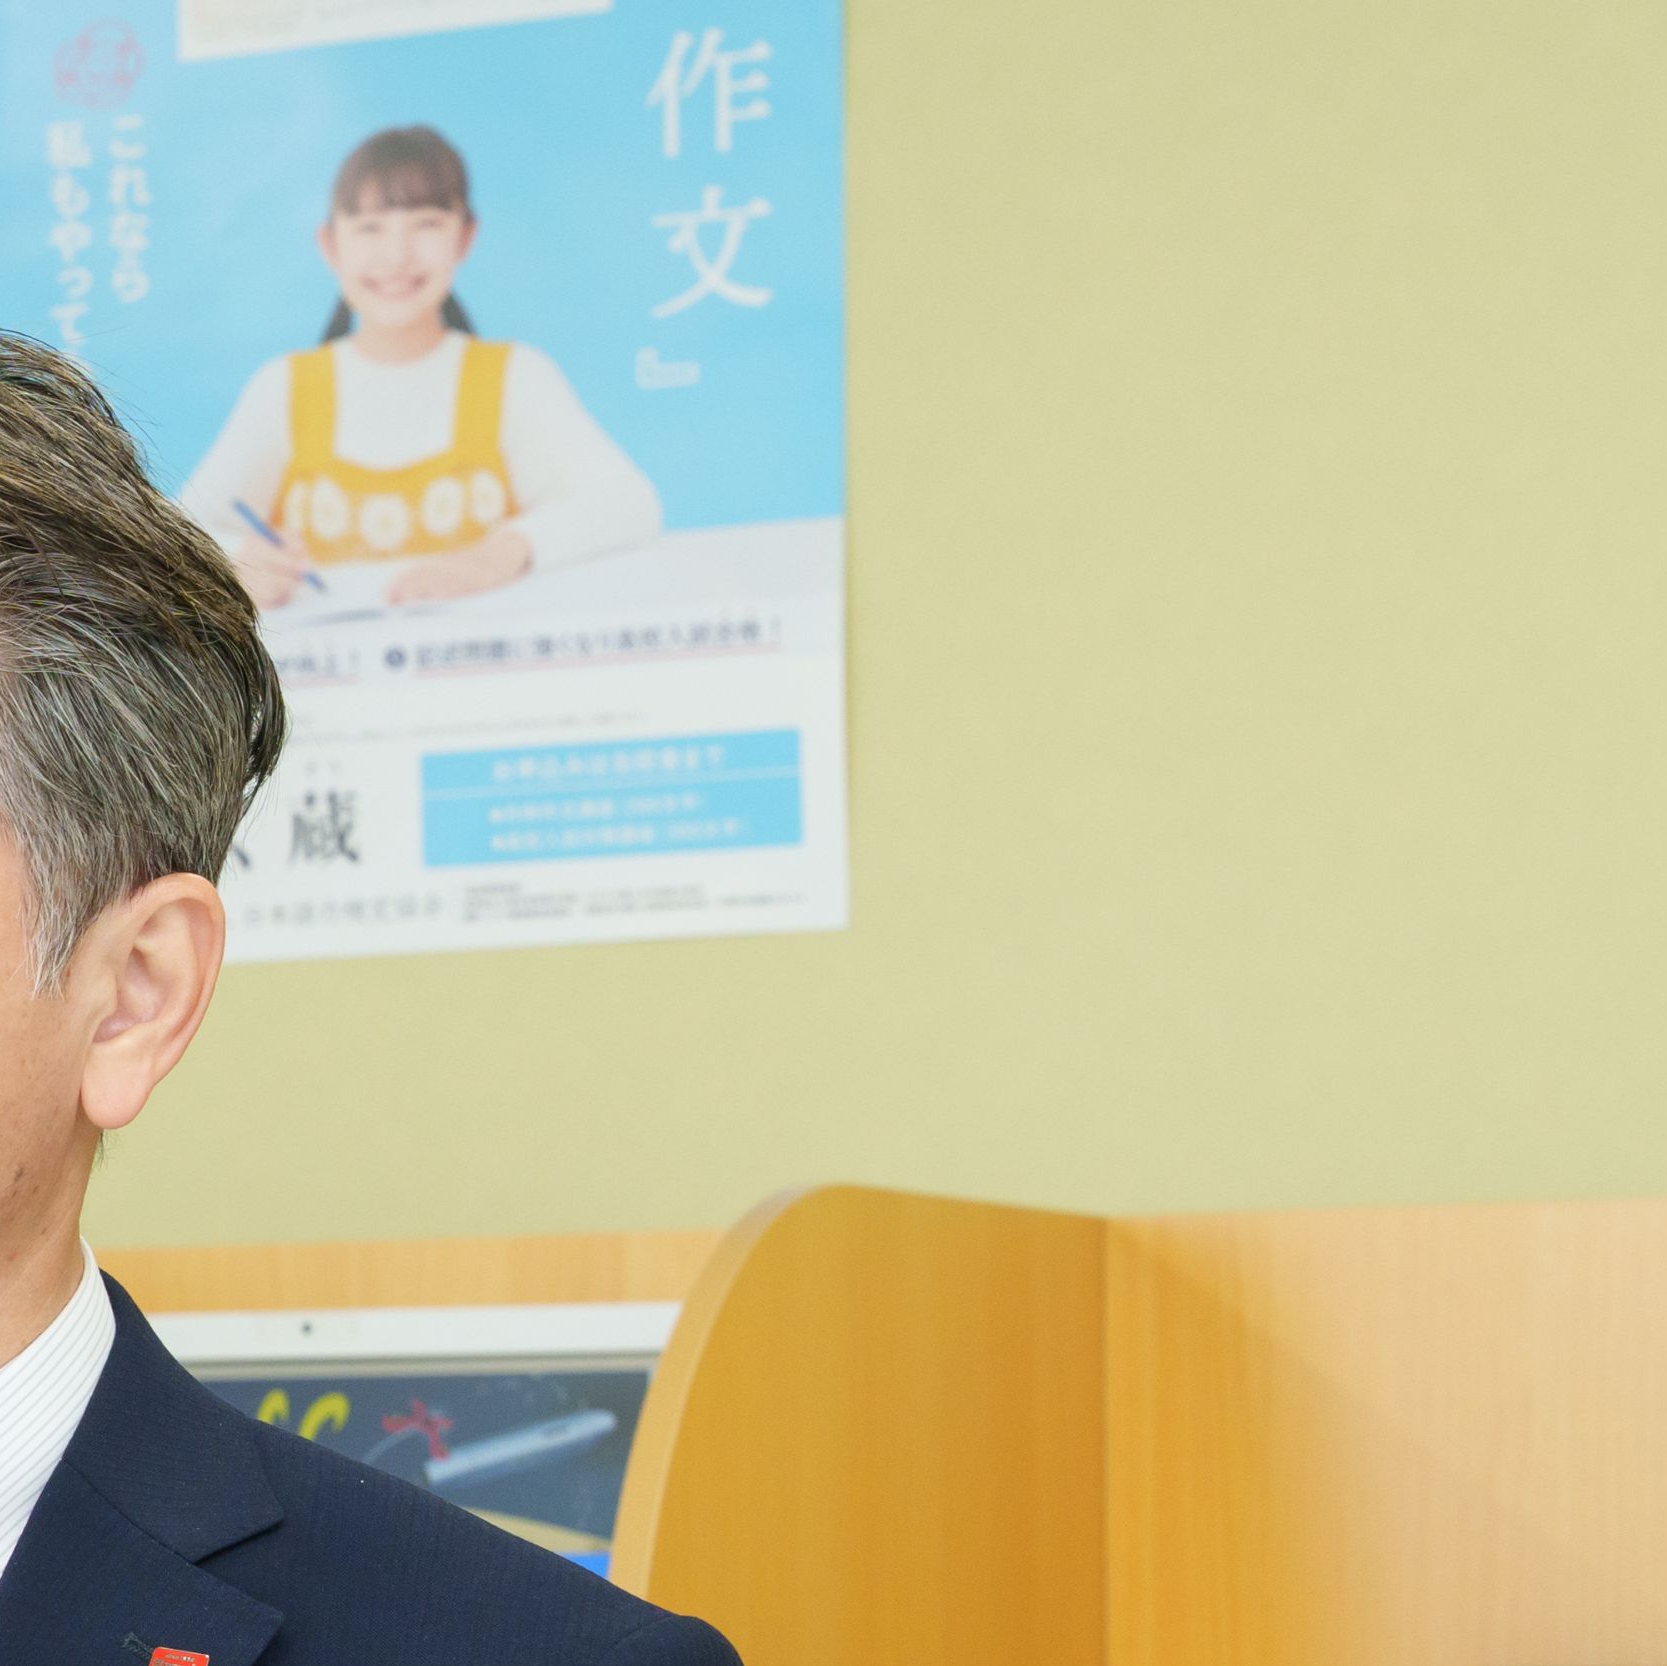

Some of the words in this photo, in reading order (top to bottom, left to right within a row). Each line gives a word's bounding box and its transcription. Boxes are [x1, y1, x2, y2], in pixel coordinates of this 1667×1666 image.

[107, 113, 154, 304] これなら
[287, 788, 362, 866] 蔵
